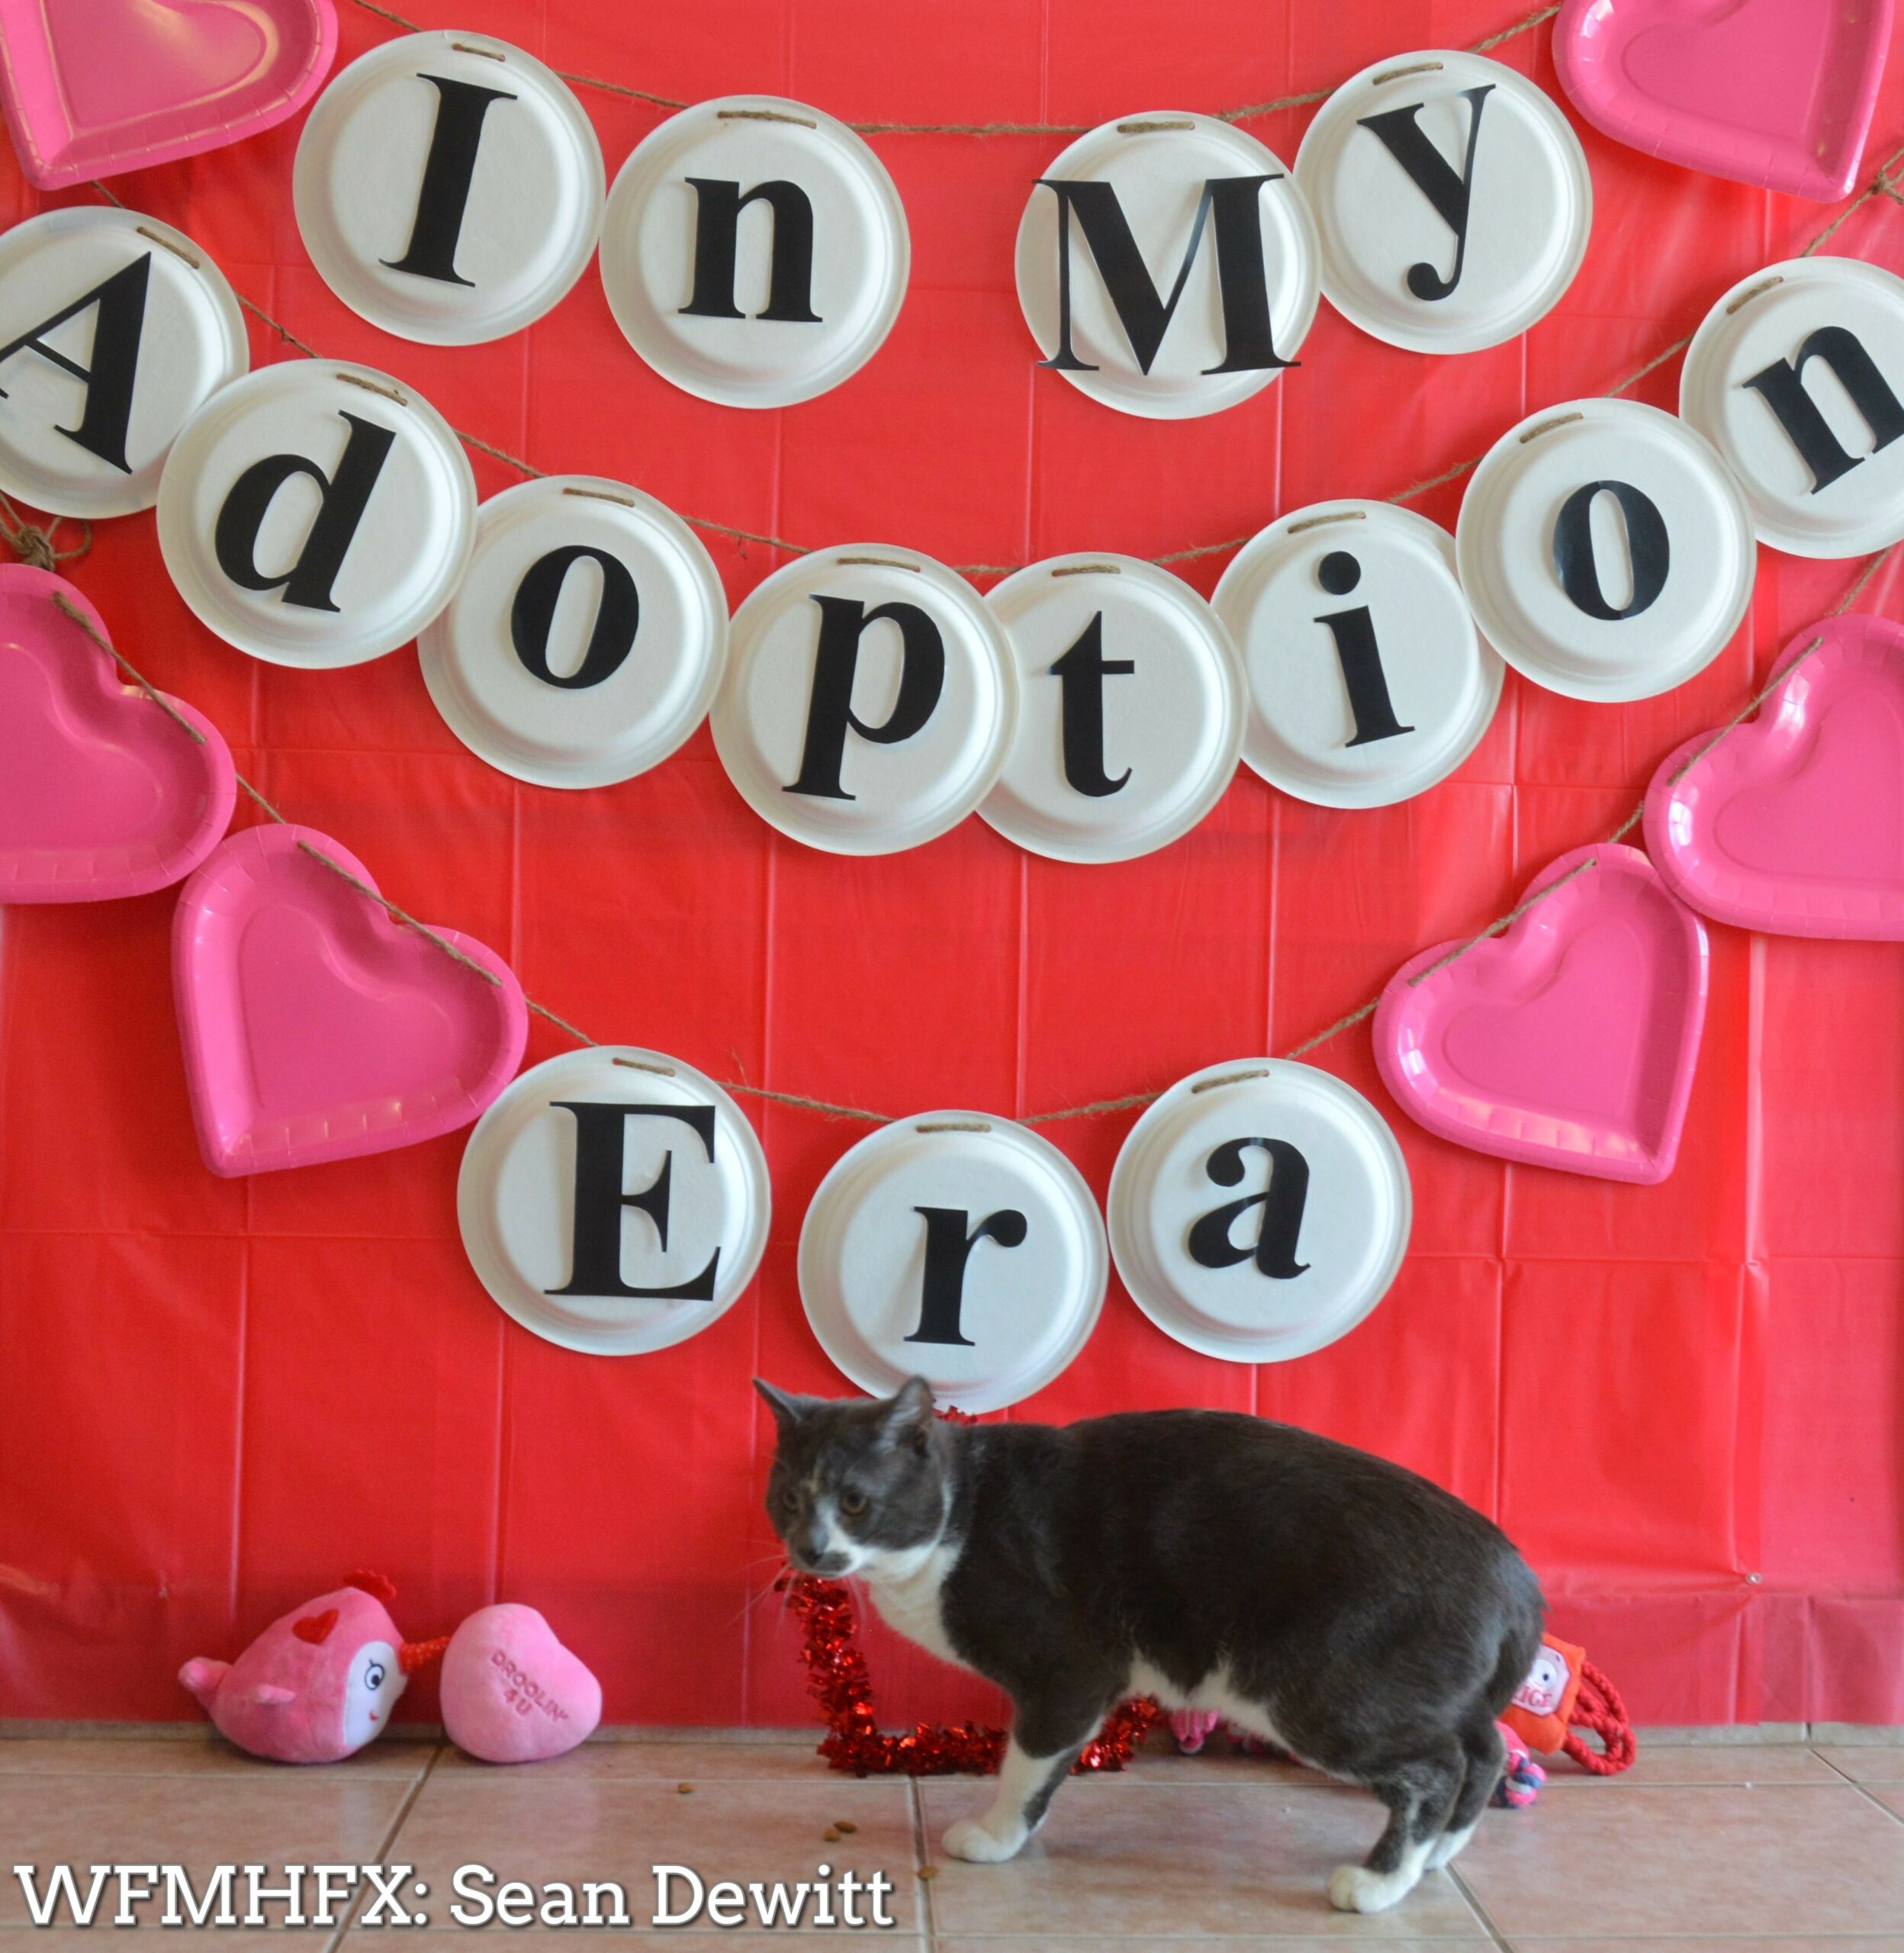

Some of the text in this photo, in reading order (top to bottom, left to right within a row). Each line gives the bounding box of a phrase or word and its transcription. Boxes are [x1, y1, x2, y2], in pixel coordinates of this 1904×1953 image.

[381, 73, 1497, 375] In My
[0, 252, 1904, 801] Adoption
[545, 1101, 1311, 1347] Era
